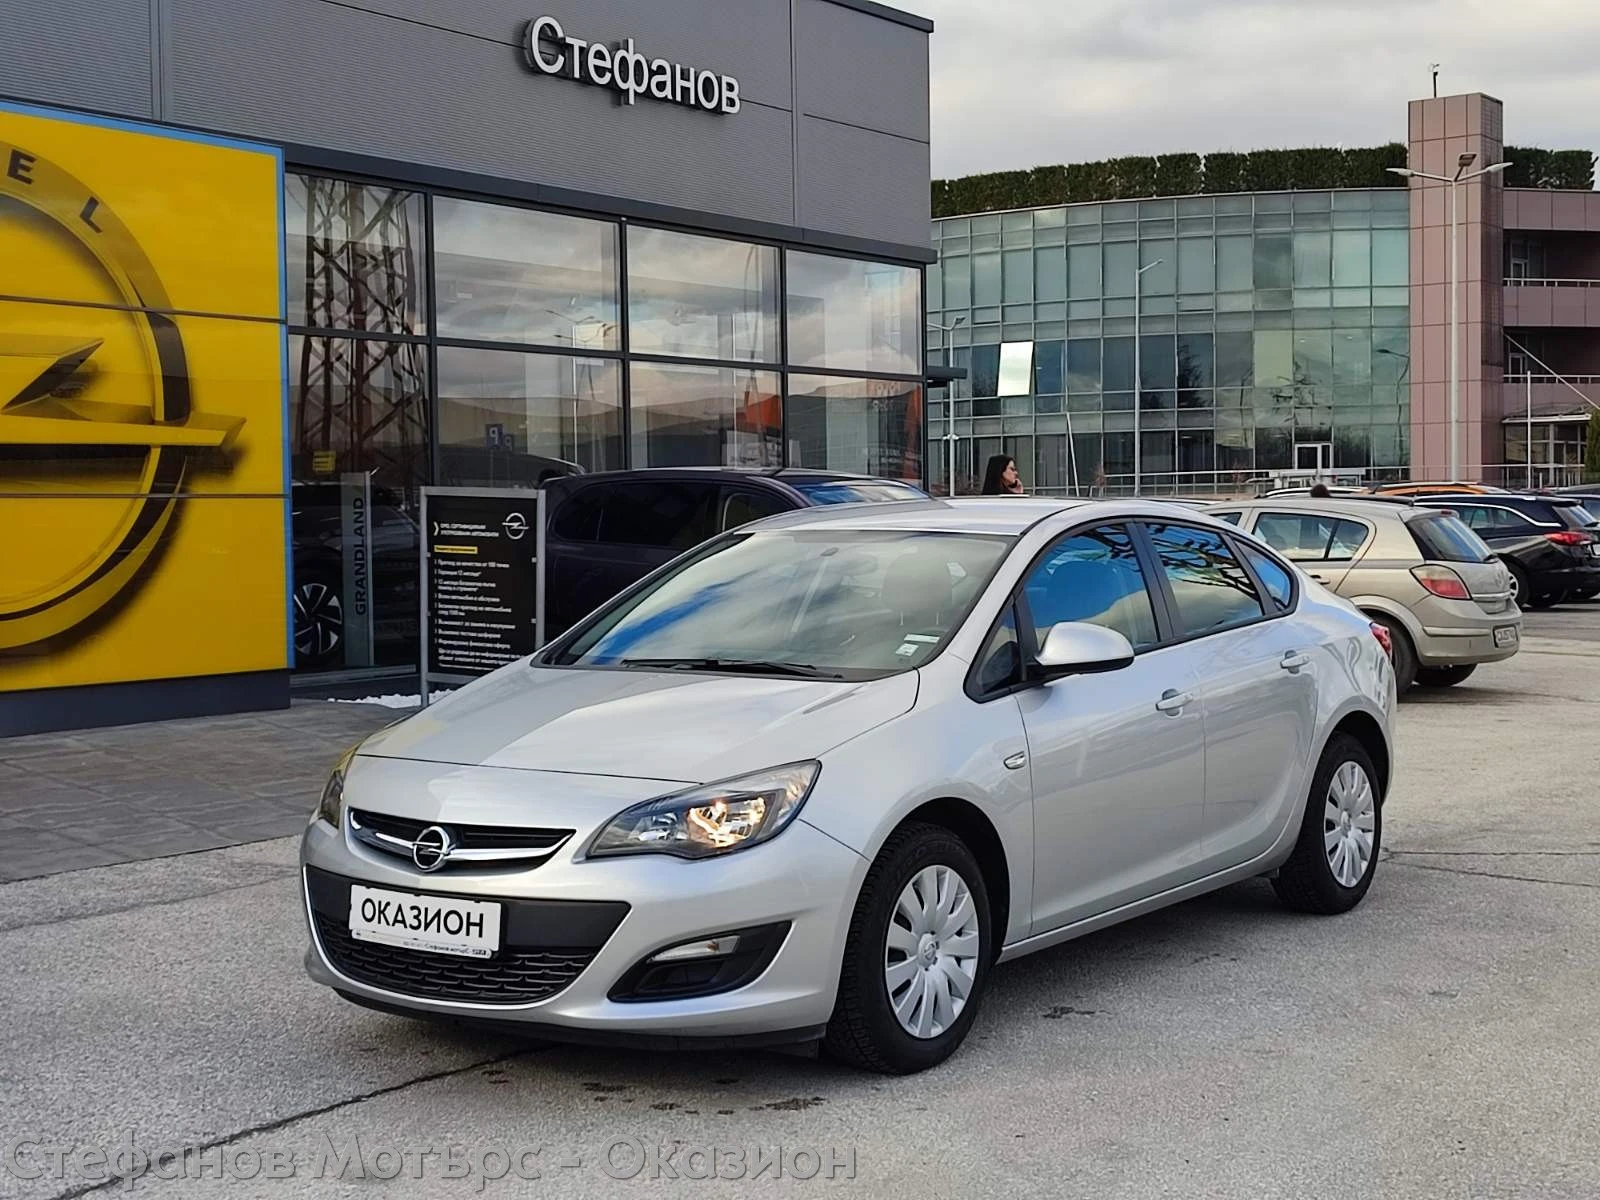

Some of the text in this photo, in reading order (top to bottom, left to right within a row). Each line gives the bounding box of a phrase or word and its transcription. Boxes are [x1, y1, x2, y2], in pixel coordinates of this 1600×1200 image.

[529, 15, 741, 114] Стефанов
[352, 496, 367, 616] GRANDLAND
[361, 897, 484, 939] ОКАЗИОН
